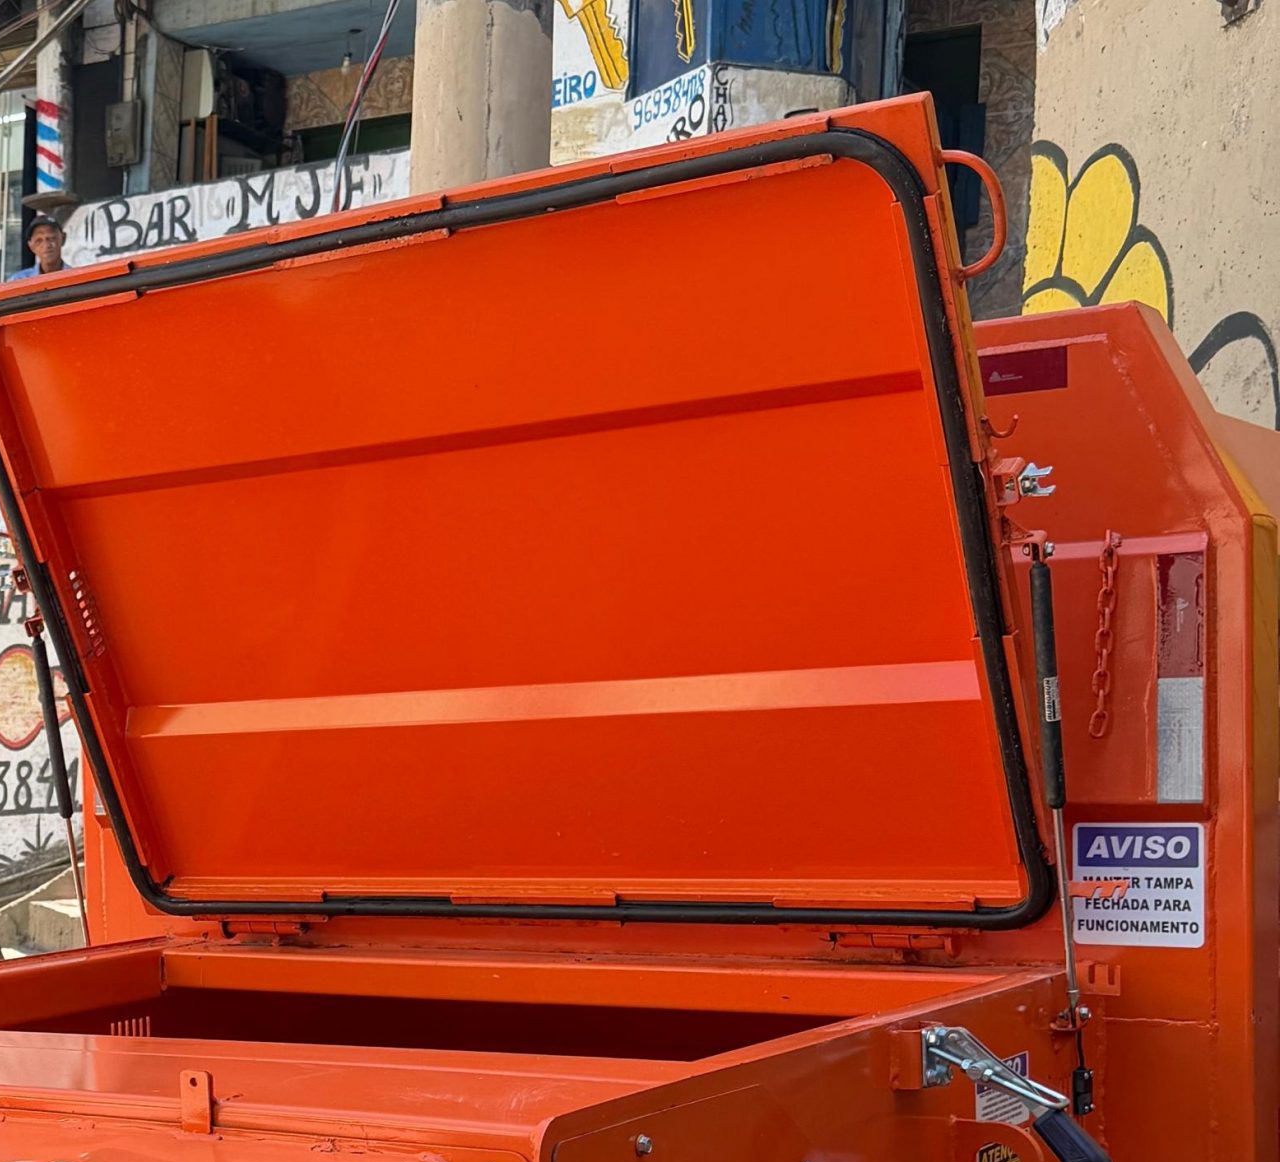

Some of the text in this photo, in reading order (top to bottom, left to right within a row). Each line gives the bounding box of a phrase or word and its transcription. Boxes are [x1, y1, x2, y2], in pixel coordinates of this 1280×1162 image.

[1086, 835, 1192, 860] AVISO
[1145, 877, 1194, 890] TAMPA
[1085, 898, 1192, 912] FECHADA PARA
[1077, 919, 1199, 934] FUNCIONAMENTO
